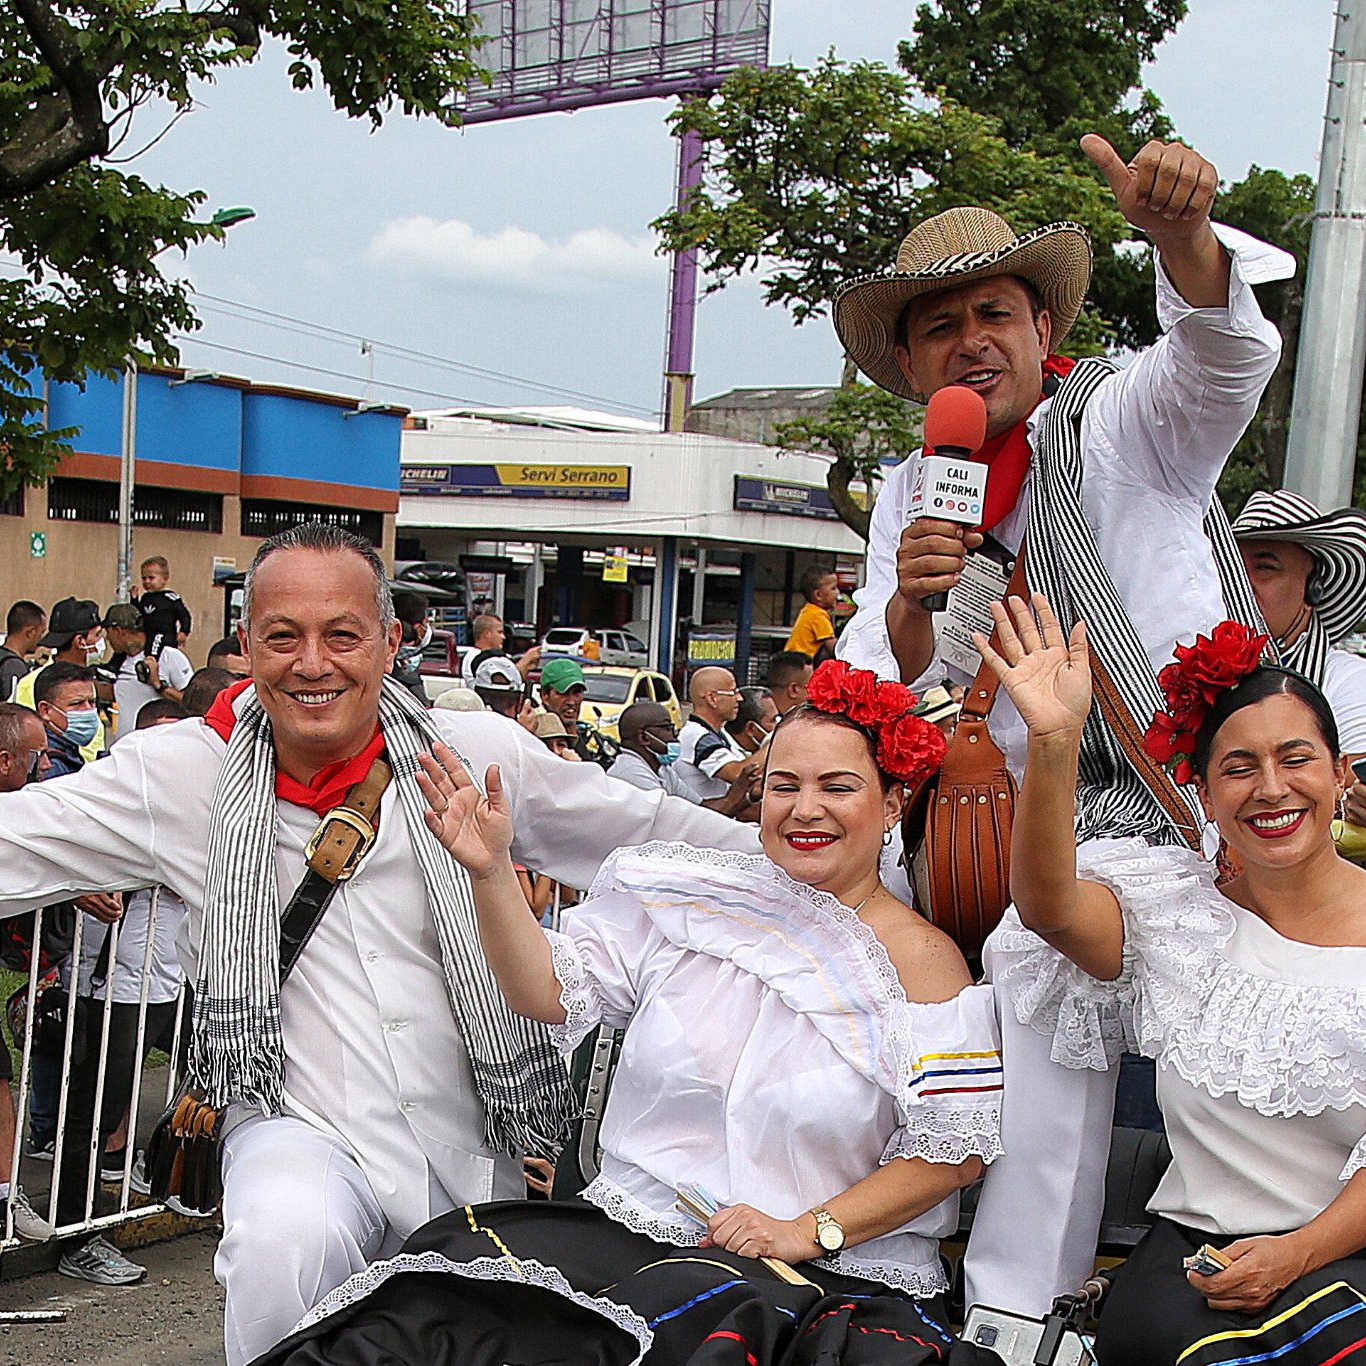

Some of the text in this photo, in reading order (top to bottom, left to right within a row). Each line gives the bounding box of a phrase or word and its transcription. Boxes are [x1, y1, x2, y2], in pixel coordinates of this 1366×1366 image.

[400, 468, 447, 480] ICHELIN
[520, 467, 618, 483] Servi Serrano
[947, 467, 969, 481] CALI
[935, 481, 979, 498] INFORMA
